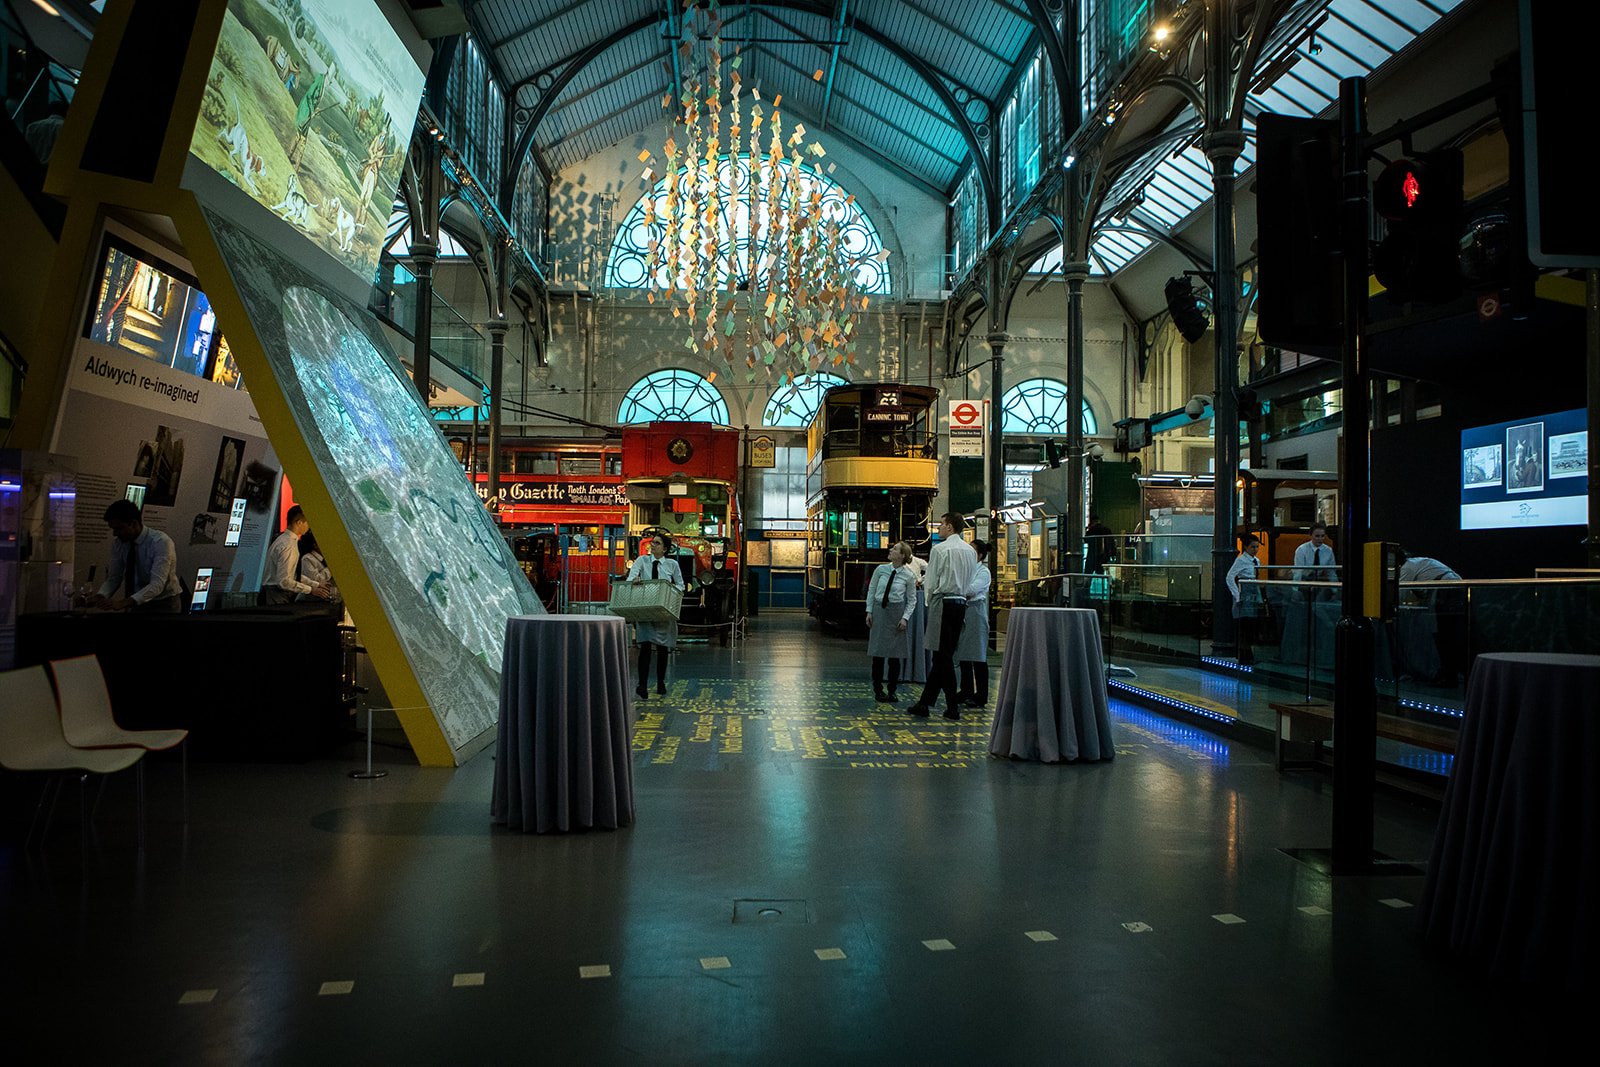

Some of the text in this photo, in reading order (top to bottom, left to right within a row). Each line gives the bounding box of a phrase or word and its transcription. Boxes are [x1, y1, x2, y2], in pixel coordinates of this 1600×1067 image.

[84, 356, 200, 404] Aldwych re-imagined
[867, 413, 909, 422] CANNING TOWN
[510, 482, 565, 500] Gazette
[567, 484, 616, 494] North London's
[614, 494, 630, 506] Pap
